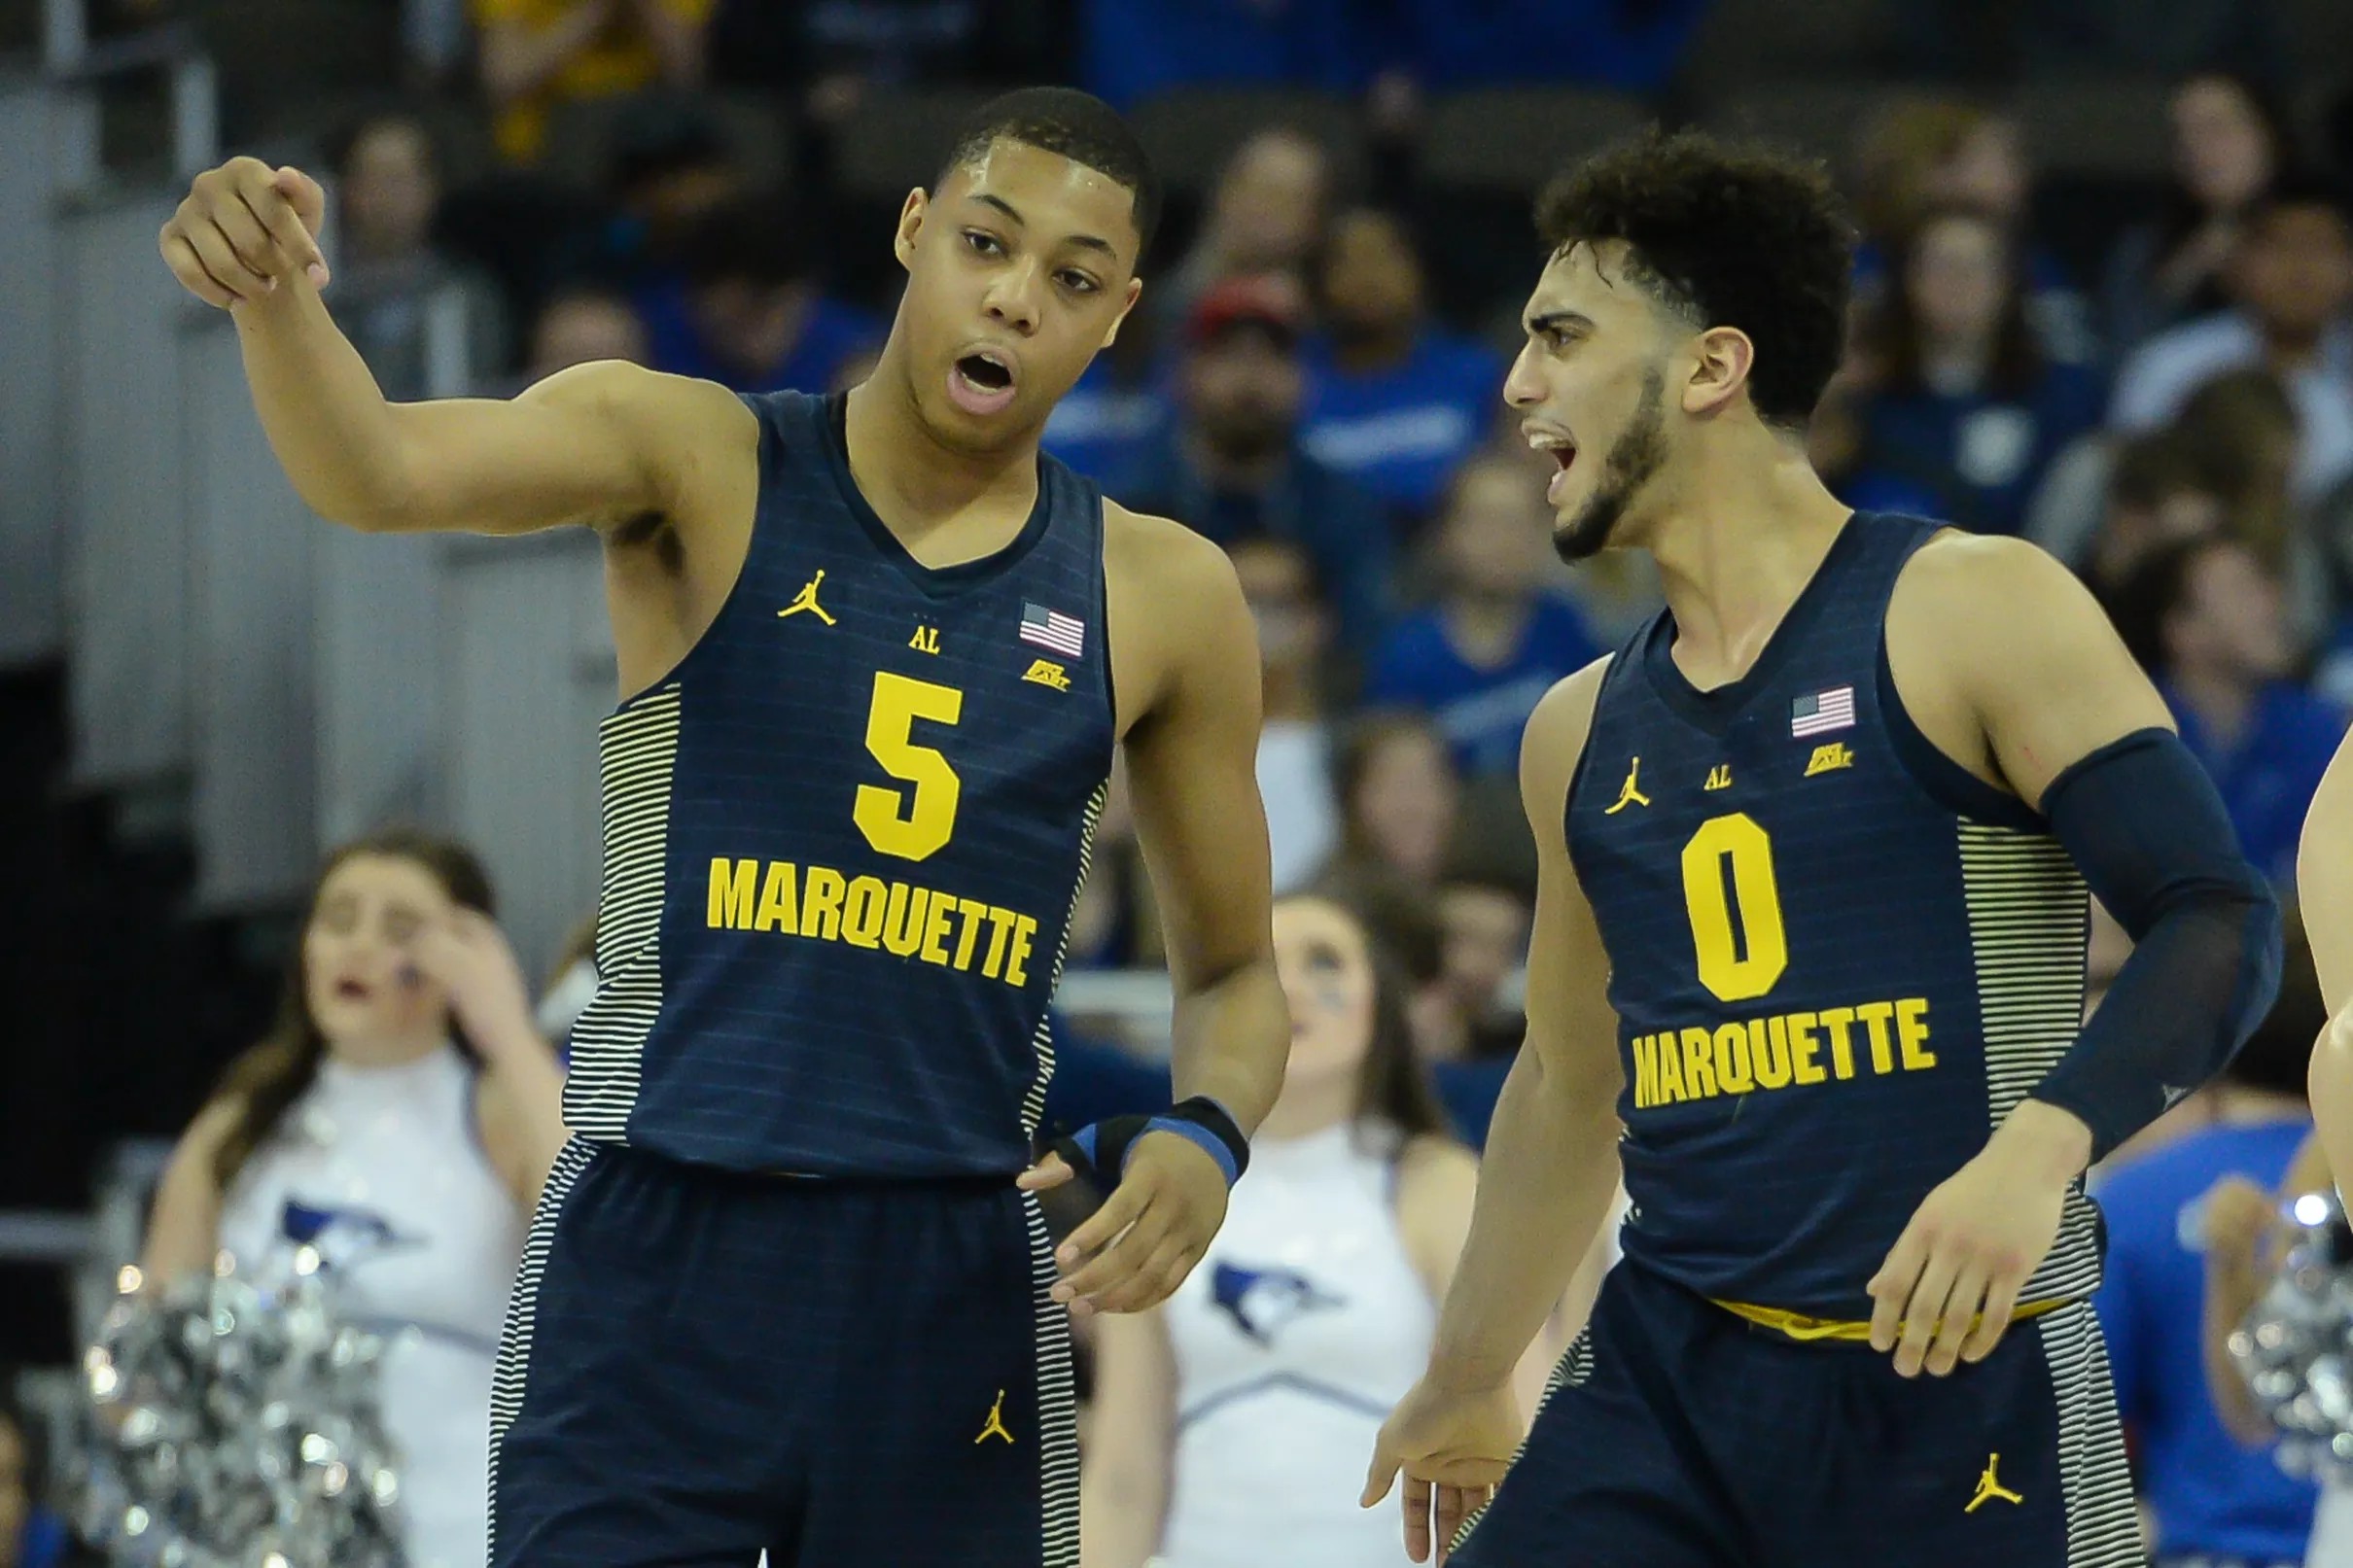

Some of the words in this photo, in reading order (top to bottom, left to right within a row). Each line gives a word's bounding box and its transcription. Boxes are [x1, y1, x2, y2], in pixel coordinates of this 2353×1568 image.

[908, 625, 940, 654] AL
[853, 671, 963, 862] 5
[1703, 764, 1732, 791] AL
[707, 856, 1037, 987] MARQUETTE
[1681, 812, 1788, 1002] 0
[1633, 997, 1937, 1108] MARQUETTE
